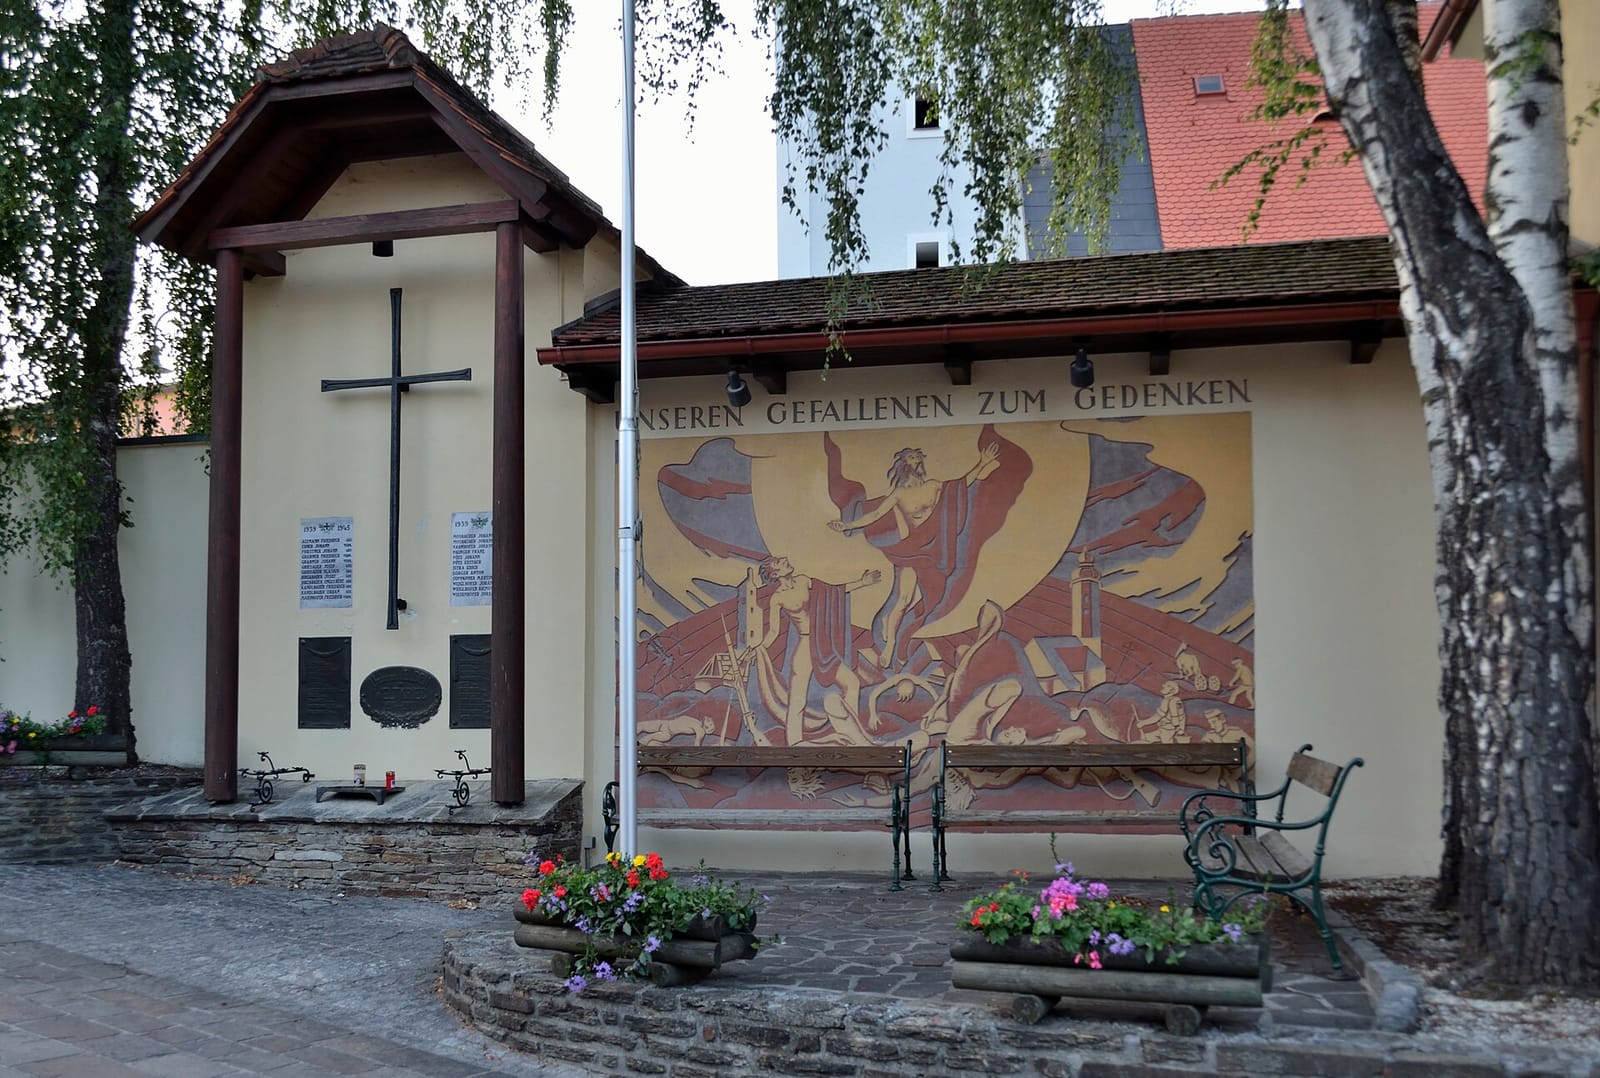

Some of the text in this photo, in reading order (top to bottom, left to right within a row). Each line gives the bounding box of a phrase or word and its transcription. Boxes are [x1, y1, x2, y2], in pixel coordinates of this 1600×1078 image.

[766, 393, 954, 425] GEFALLENEN
[977, 389, 1046, 415] ZUM
[1073, 379, 1253, 410] GEDENKEN
